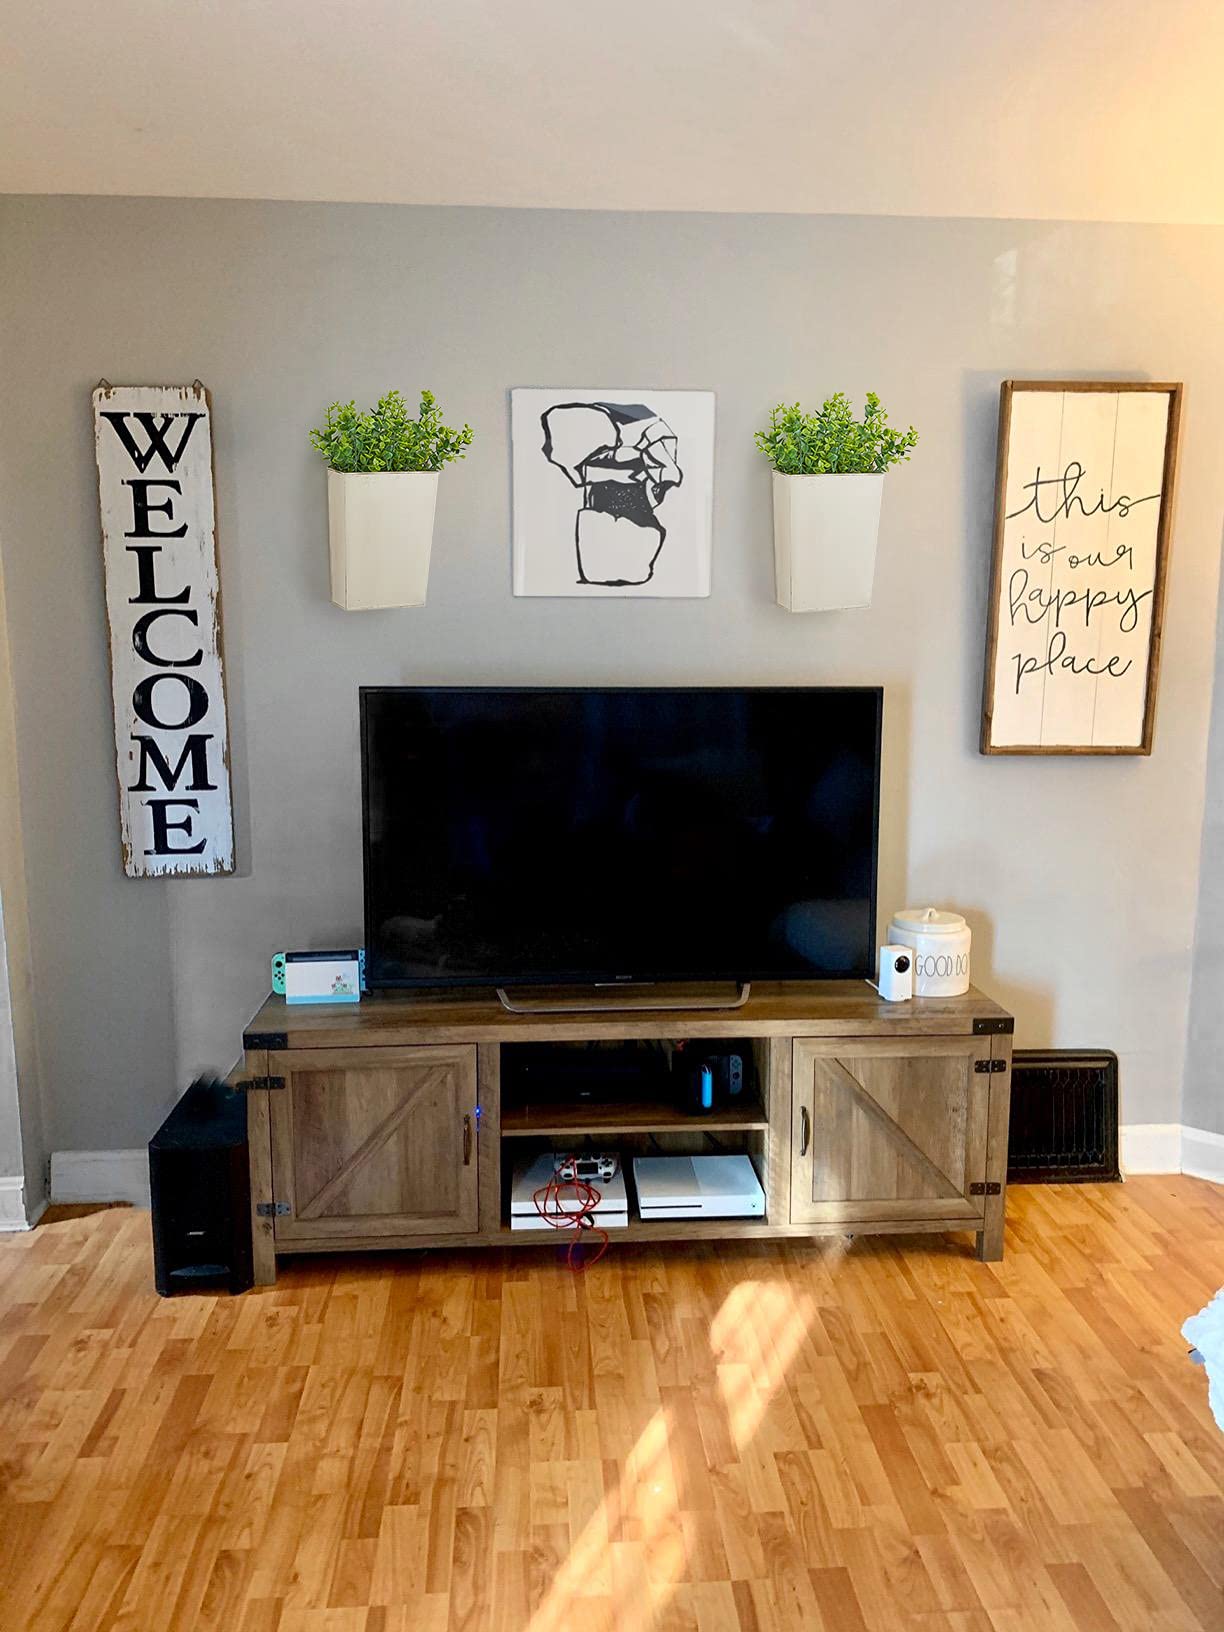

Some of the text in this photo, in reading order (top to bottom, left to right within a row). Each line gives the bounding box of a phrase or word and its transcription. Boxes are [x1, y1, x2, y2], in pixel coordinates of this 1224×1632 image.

[1006, 461, 1161, 523] this
[1021, 535, 1133, 570] is our
[1009, 568, 1153, 633] happy
[100, 411, 218, 857] WELCOME
[1011, 631, 1133, 694] place
[914, 954, 953, 978] GOOD
